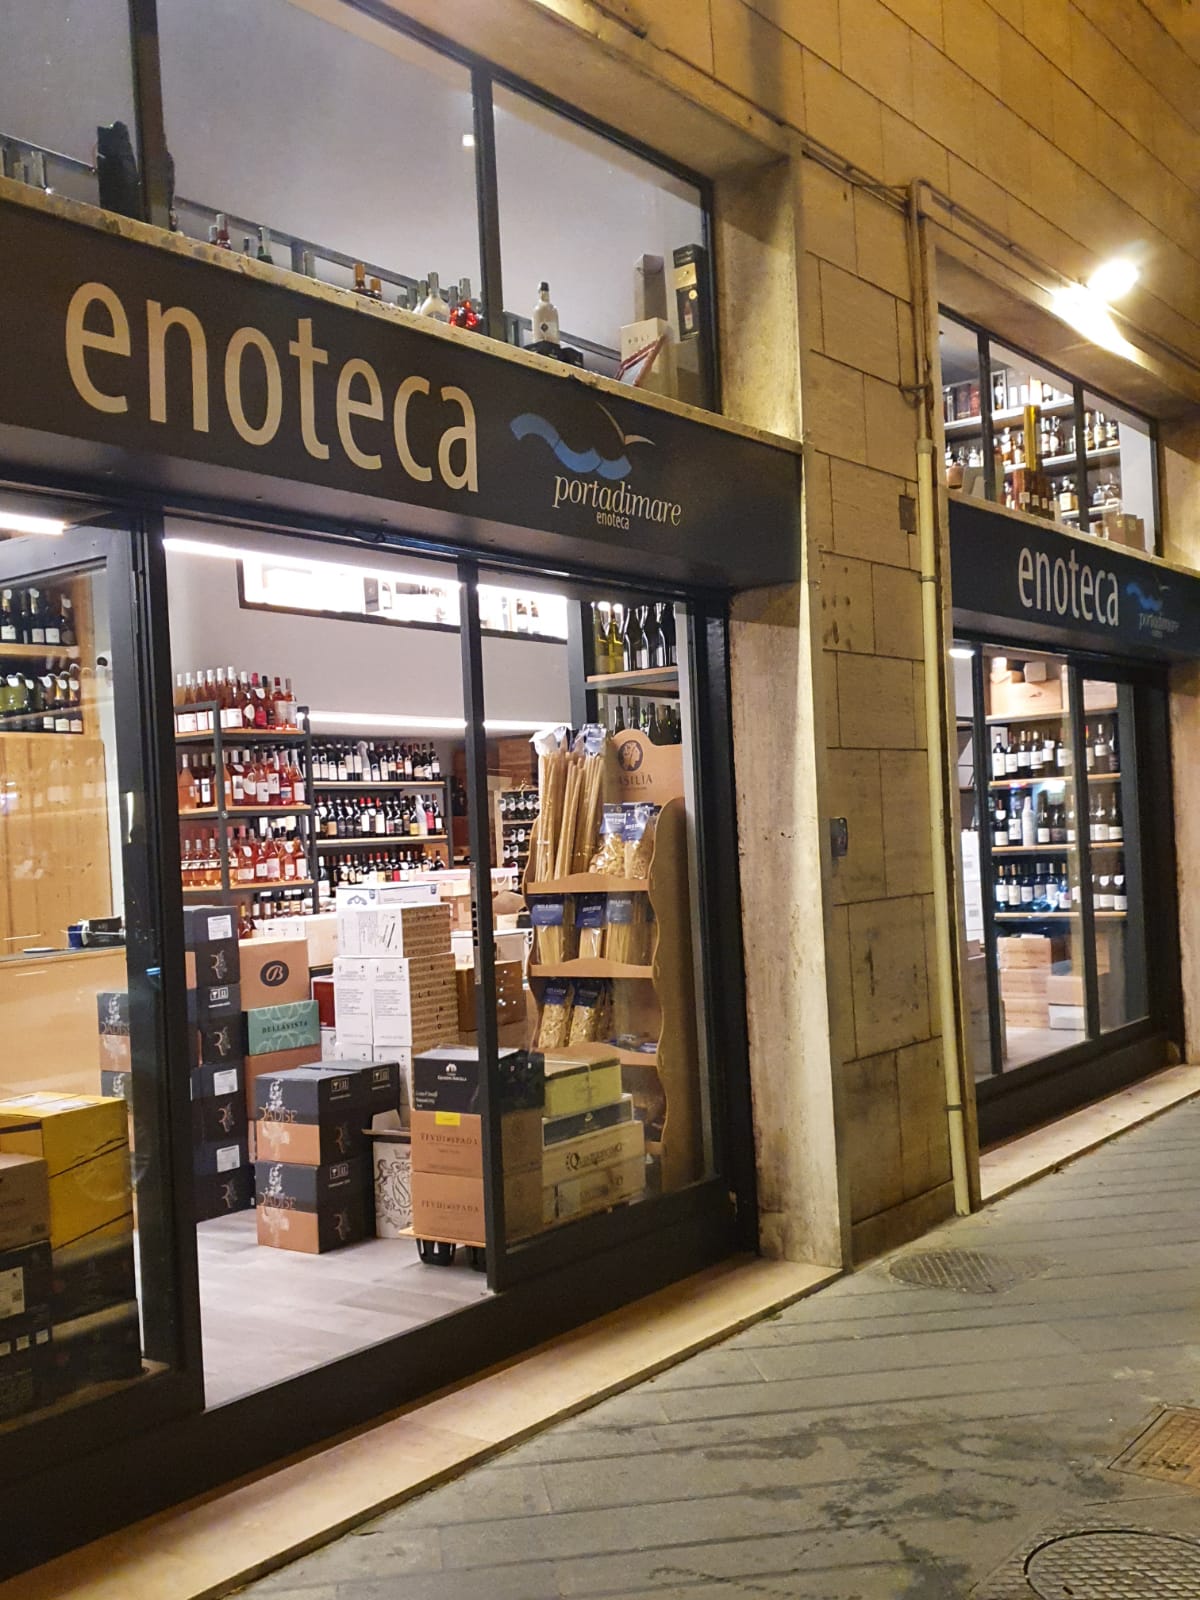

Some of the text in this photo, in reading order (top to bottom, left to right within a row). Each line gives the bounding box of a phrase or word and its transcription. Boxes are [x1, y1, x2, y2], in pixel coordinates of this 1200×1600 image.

[65, 281, 479, 493] enoteca
[552, 475, 682, 526] portadimare
[596, 510, 630, 530] enoteca
[1018, 547, 1120, 627] enoteca
